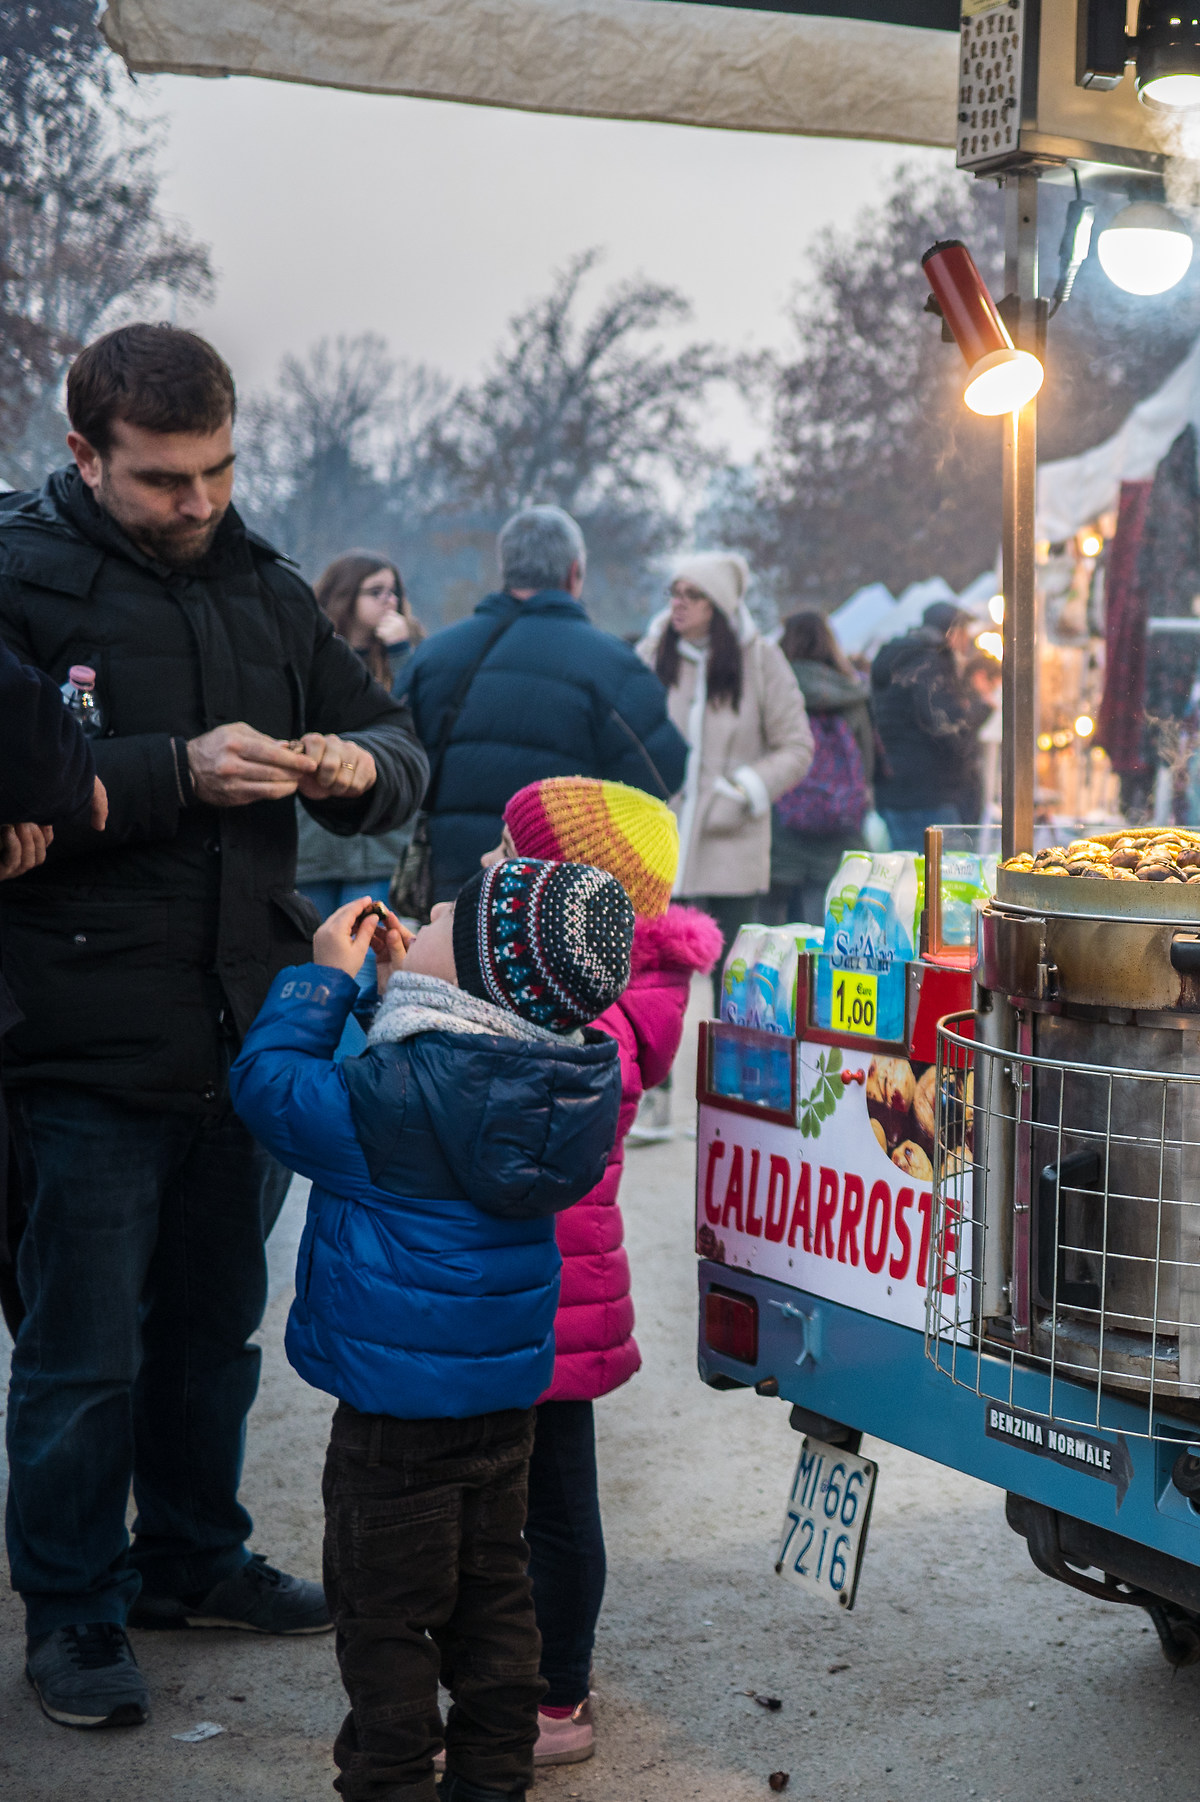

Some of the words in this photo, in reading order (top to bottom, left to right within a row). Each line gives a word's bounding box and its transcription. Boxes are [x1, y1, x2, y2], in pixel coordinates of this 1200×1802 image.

[836, 979, 875, 1030] 1,00
[704, 1139, 964, 1296] CALDARROSTE
[989, 1408, 1043, 1446] BENZINA
[1048, 1429, 1111, 1471] NORMALE
[779, 1511, 851, 1591] 7216
